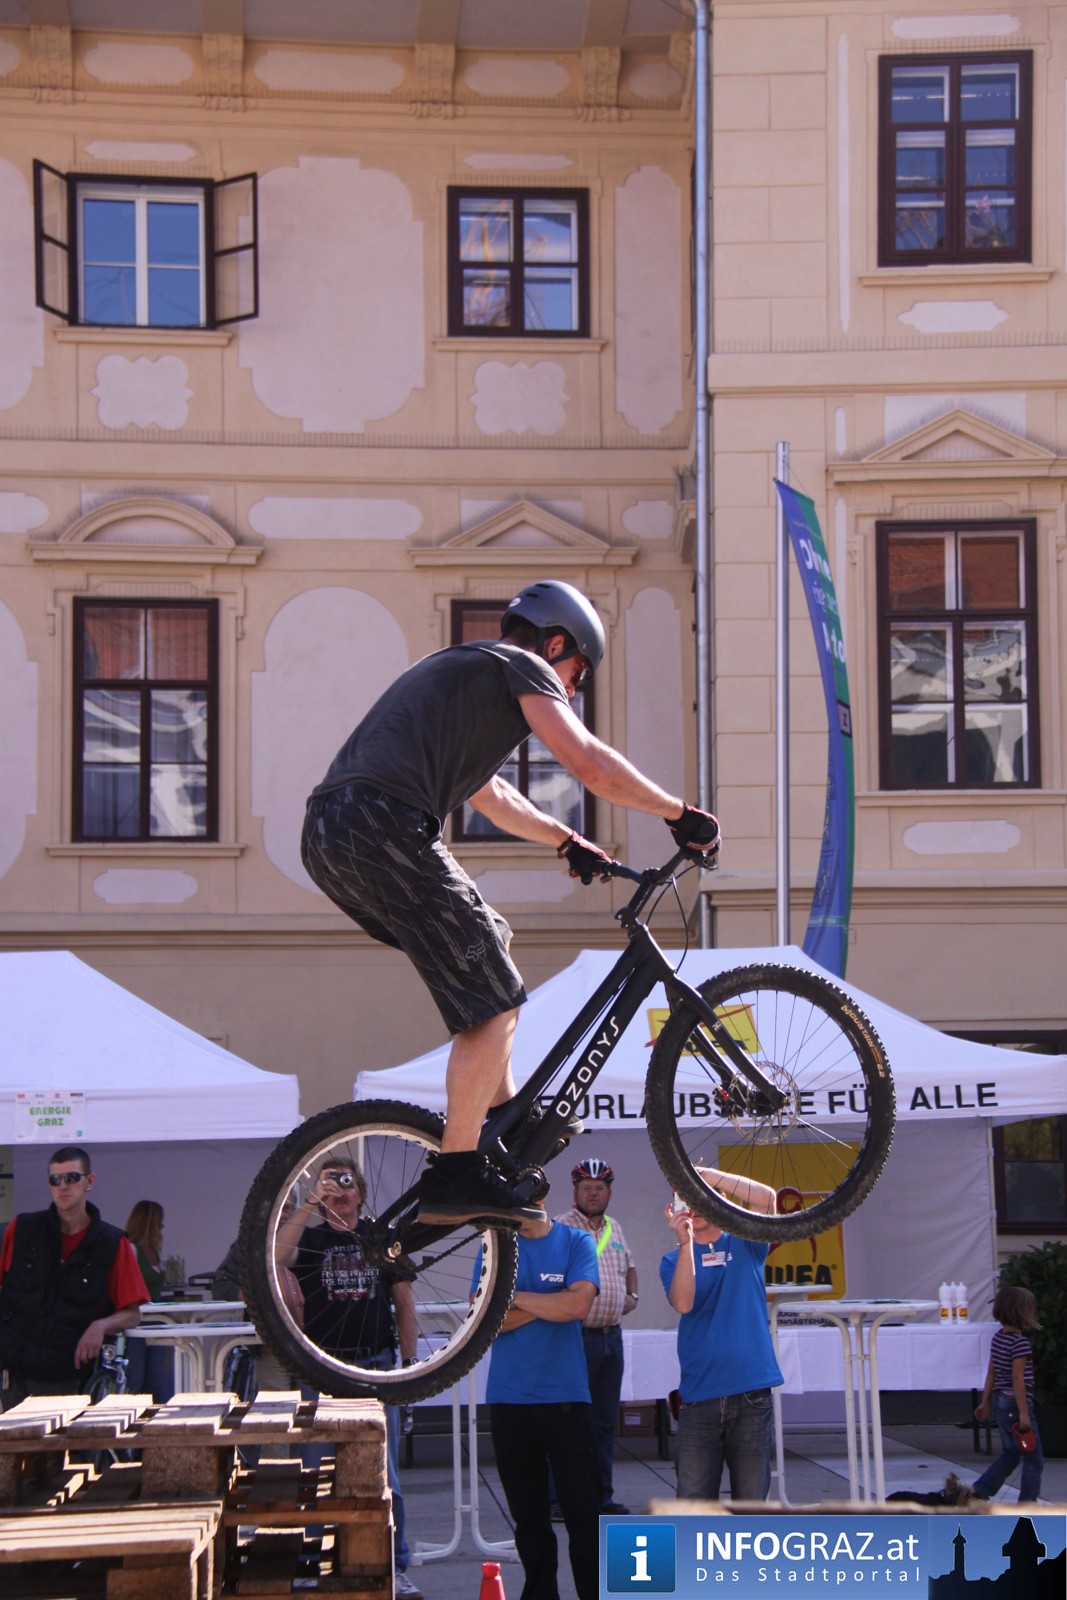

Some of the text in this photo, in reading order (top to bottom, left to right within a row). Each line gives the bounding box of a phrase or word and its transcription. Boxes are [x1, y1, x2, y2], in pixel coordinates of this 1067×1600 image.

[840, 1004, 875, 1048] MOUNTAIN
[556, 1016, 619, 1117] OZONYS
[29, 1106, 71, 1116] ENERGIE
[827, 1083, 868, 1114] FÜ
[910, 1082, 998, 1110] ALLE
[37, 1117, 64, 1127] GRAZ
